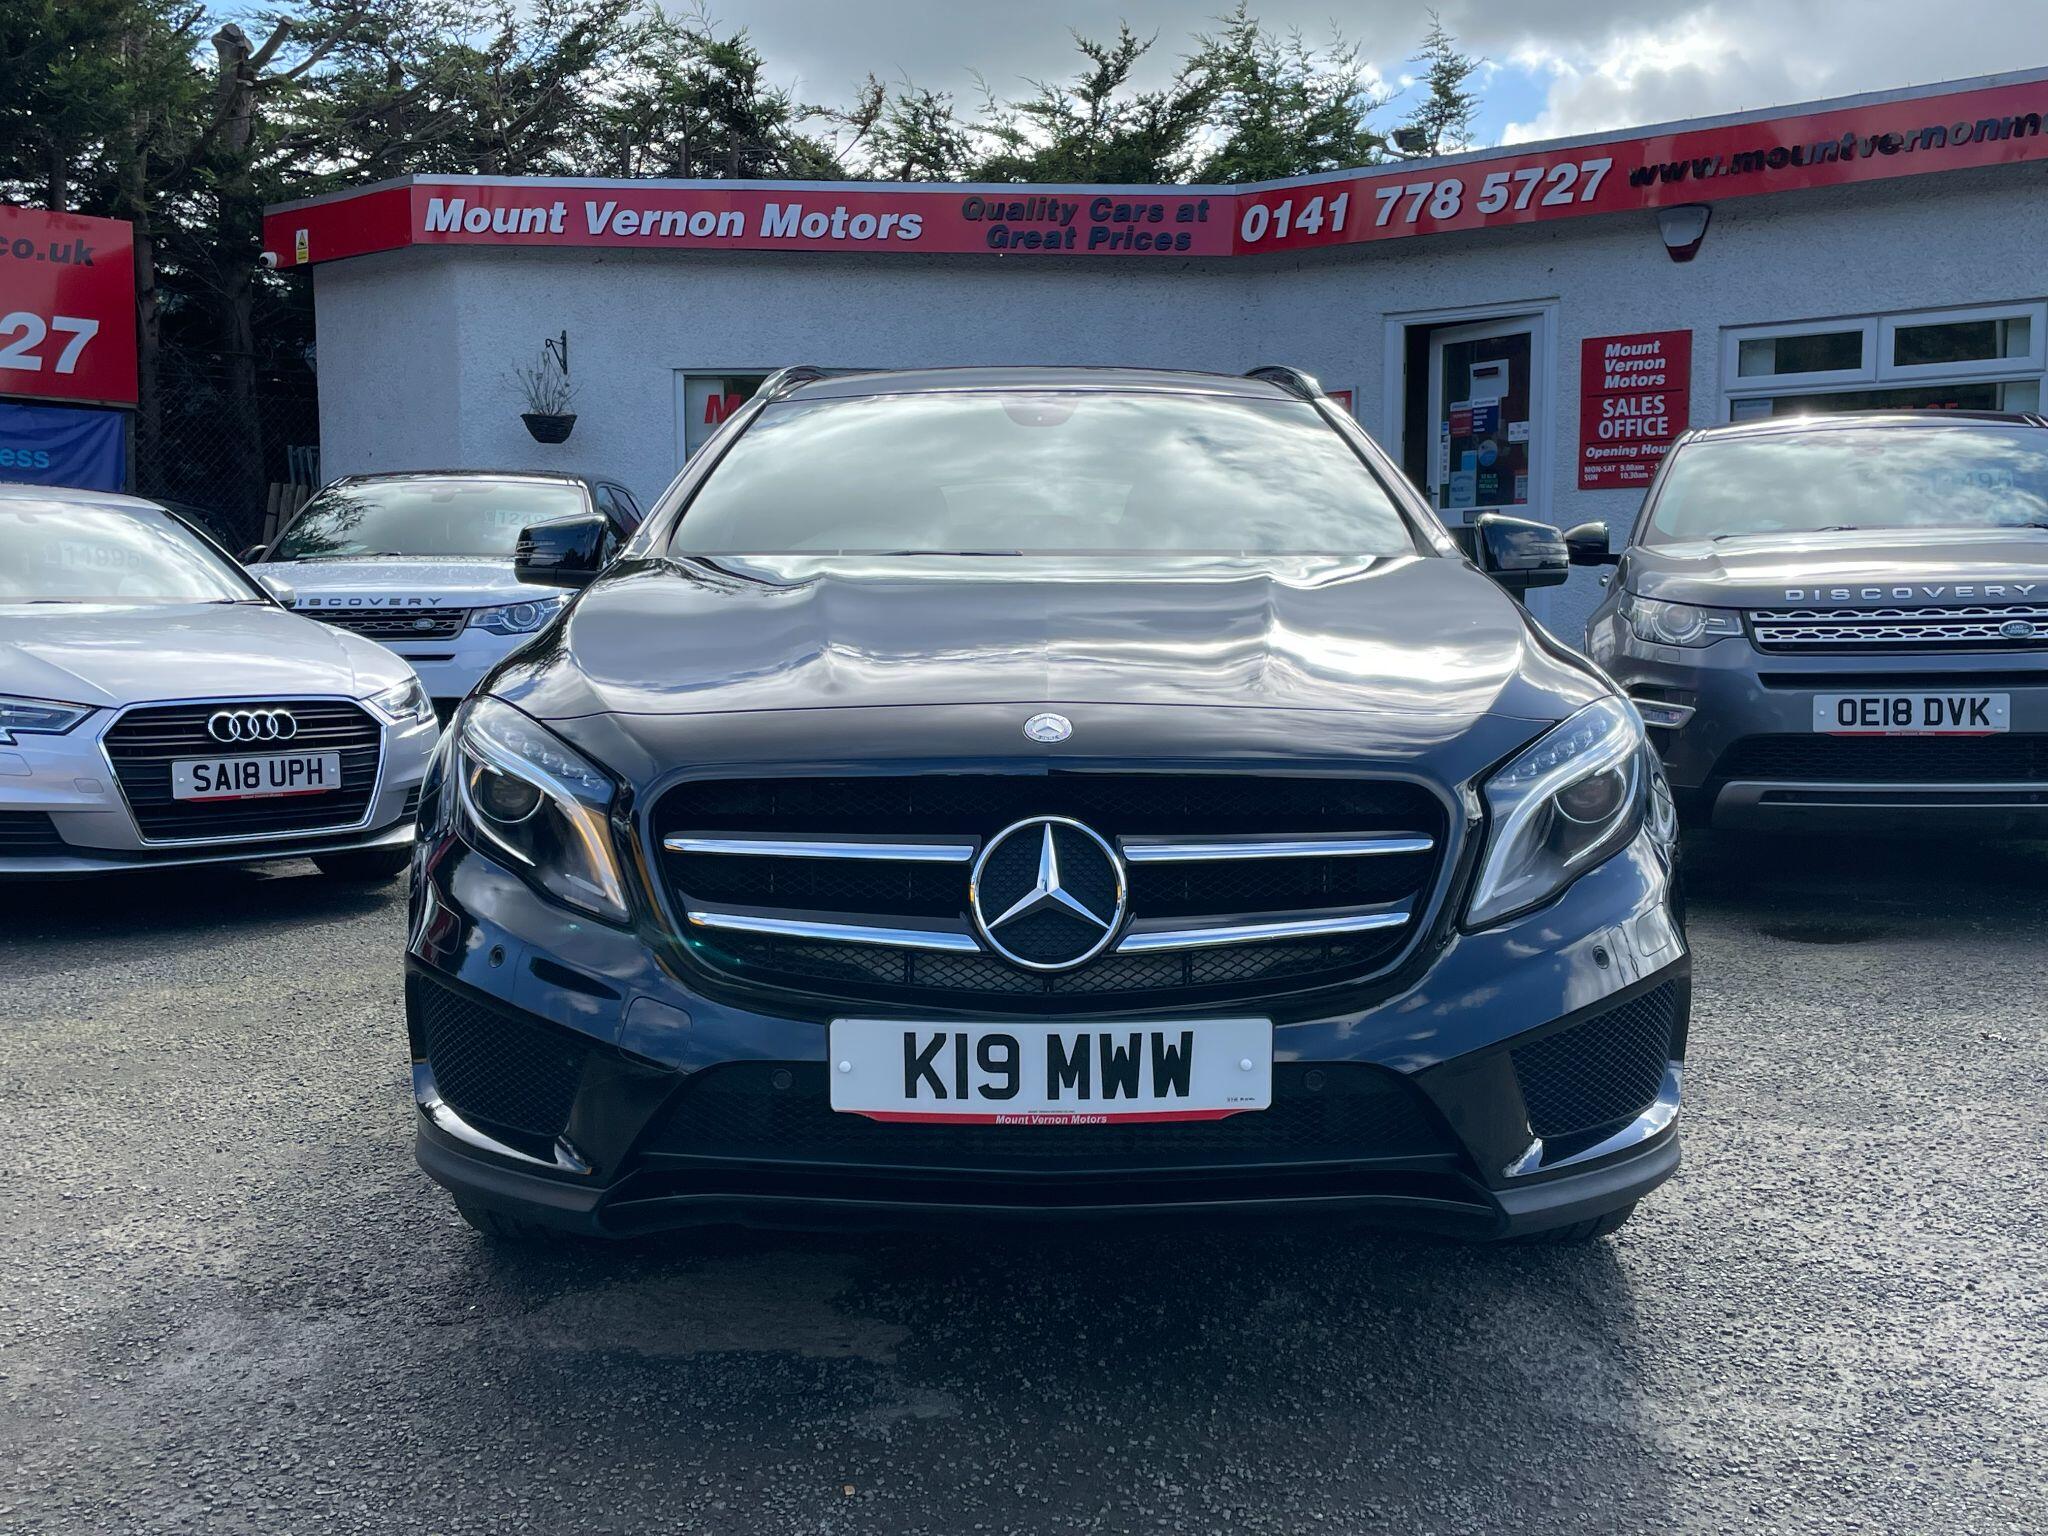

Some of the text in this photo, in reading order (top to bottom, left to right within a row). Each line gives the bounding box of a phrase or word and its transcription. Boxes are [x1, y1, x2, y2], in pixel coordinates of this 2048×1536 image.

[1629, 111, 2048, 187] www.mountvernonm
[962, 196, 1209, 226] Quality Cars at
[1241, 158, 1612, 243] 0141 778 5727
[425, 198, 923, 240] Mount Vernon Motors
[986, 225, 1192, 250] Great Prices
[0, 311, 99, 374] 27
[1605, 340, 1661, 358] Mount
[1604, 357, 1666, 373] Vernon
[1604, 374, 1666, 389] Motors
[1602, 395, 1665, 418] SALES
[1598, 416, 1669, 439] OFFICE
[1585, 443, 1672, 459] Opening Hour
[1584, 465, 1616, 474] MON-SAT
[1584, 473, 1598, 481] SUN
[298, 597, 442, 607] ISCOVERY
[1785, 584, 2036, 600] DISCOVERY
[1837, 697, 1990, 726] OE18 DVK
[192, 758, 323, 792] SA18 UPH
[903, 1031, 1194, 1100] K19 MWW
[995, 1115, 1107, 1125] Mount Vernon Motors
